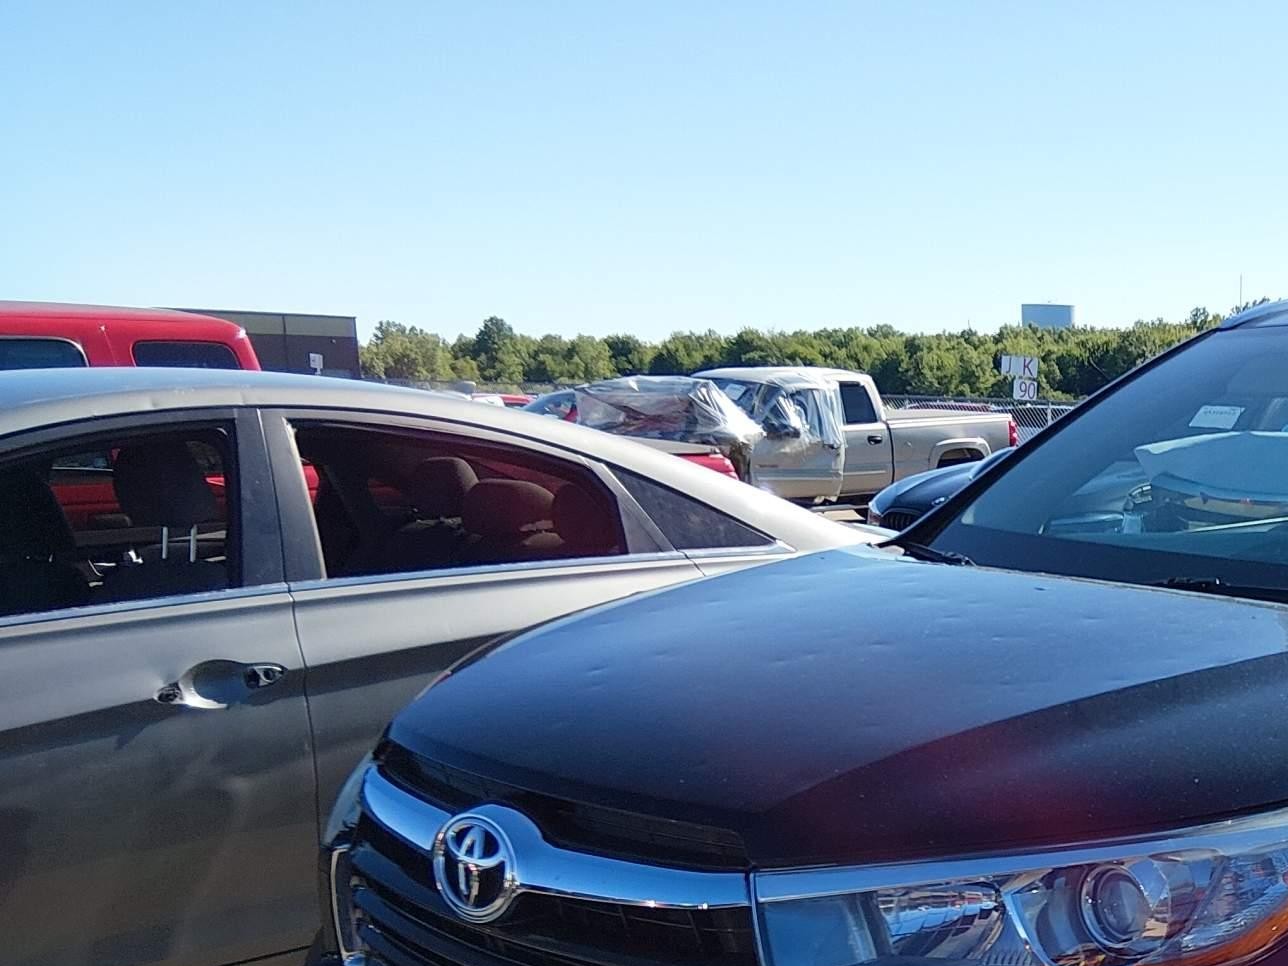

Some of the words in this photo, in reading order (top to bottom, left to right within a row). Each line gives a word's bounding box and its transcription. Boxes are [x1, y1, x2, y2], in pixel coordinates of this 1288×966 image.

[1006, 356, 1012, 374] J
[1022, 356, 1035, 376] K
[1019, 381, 1036, 400] 90
